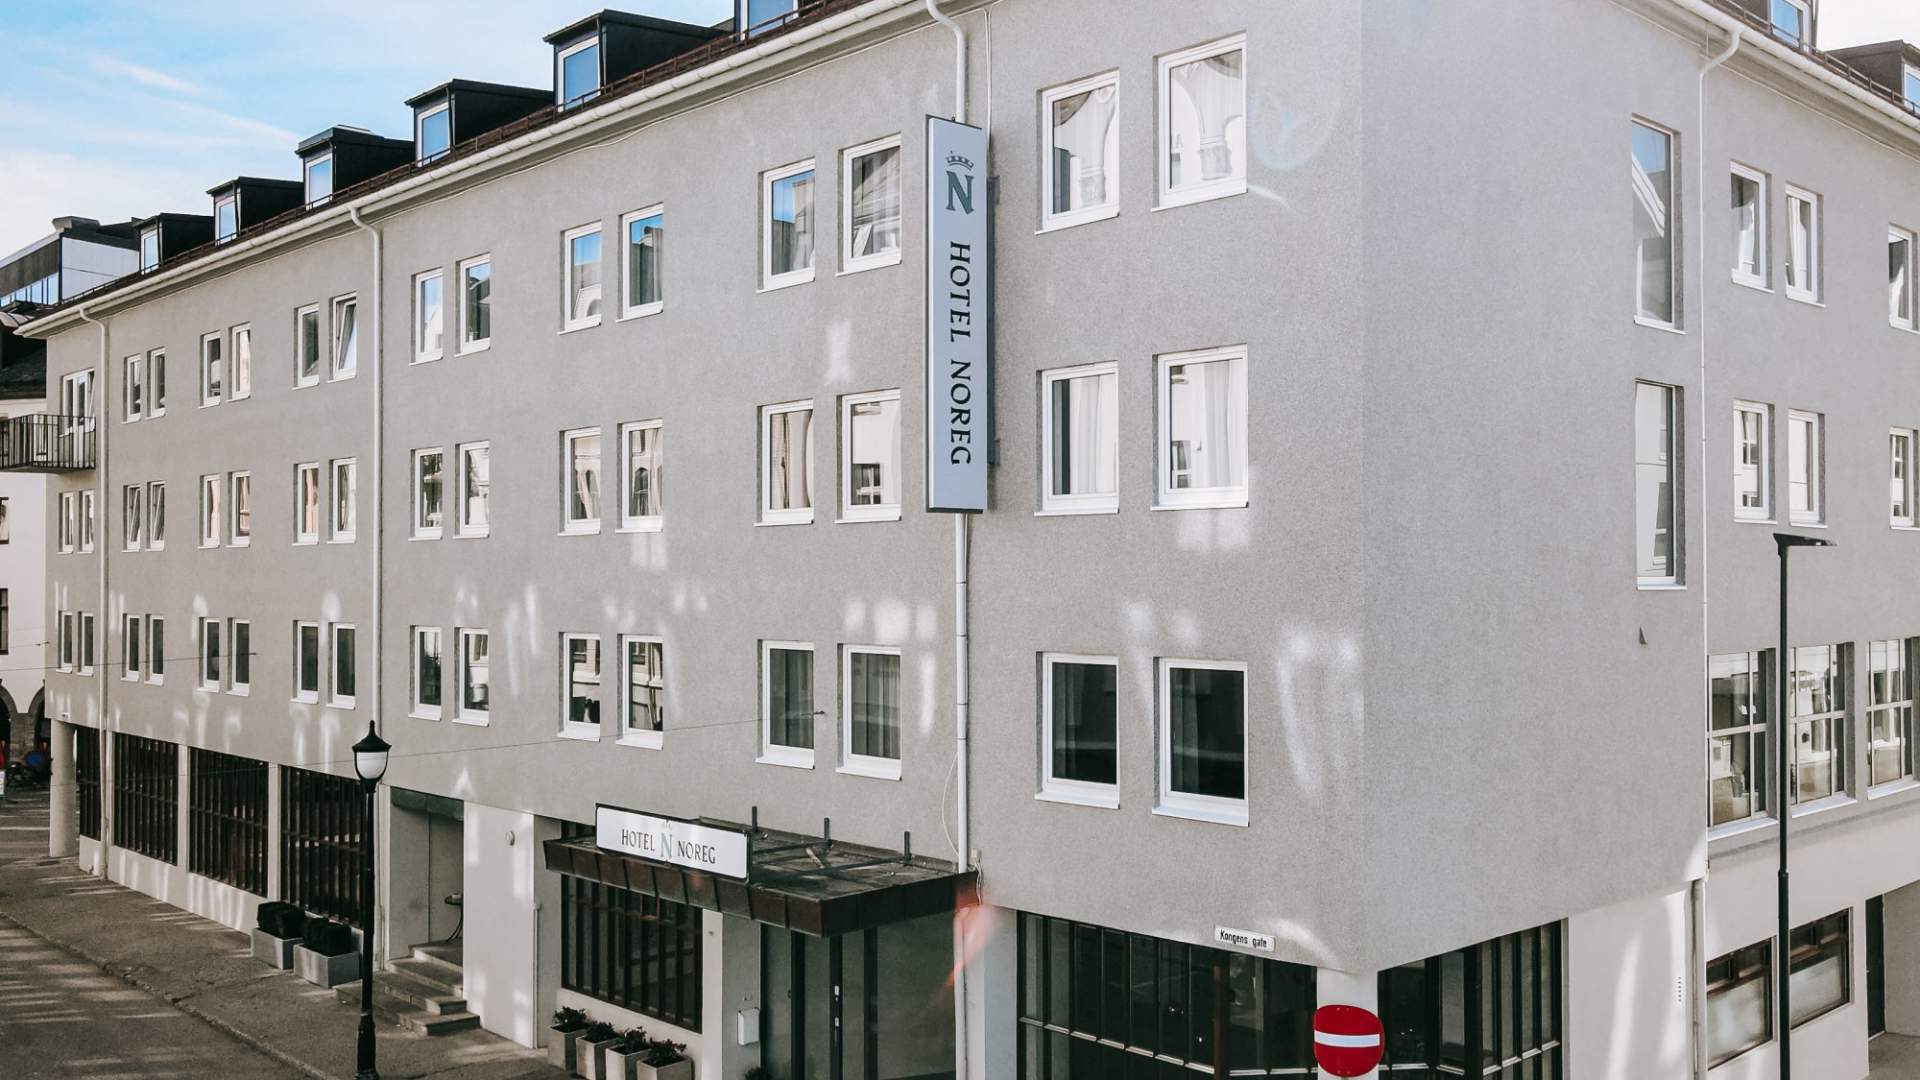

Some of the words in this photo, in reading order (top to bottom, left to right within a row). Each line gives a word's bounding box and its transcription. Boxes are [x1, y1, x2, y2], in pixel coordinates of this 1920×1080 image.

[945, 170, 974, 215] N
[950, 241, 971, 343] HOTEL
[950, 359, 972, 466] NOREG
[621, 828, 656, 852] HOTEL
[660, 832, 673, 858] N
[677, 840, 716, 864] NOREG
[1220, 929, 1248, 944] Kongens
[1252, 937, 1267, 948] gate
